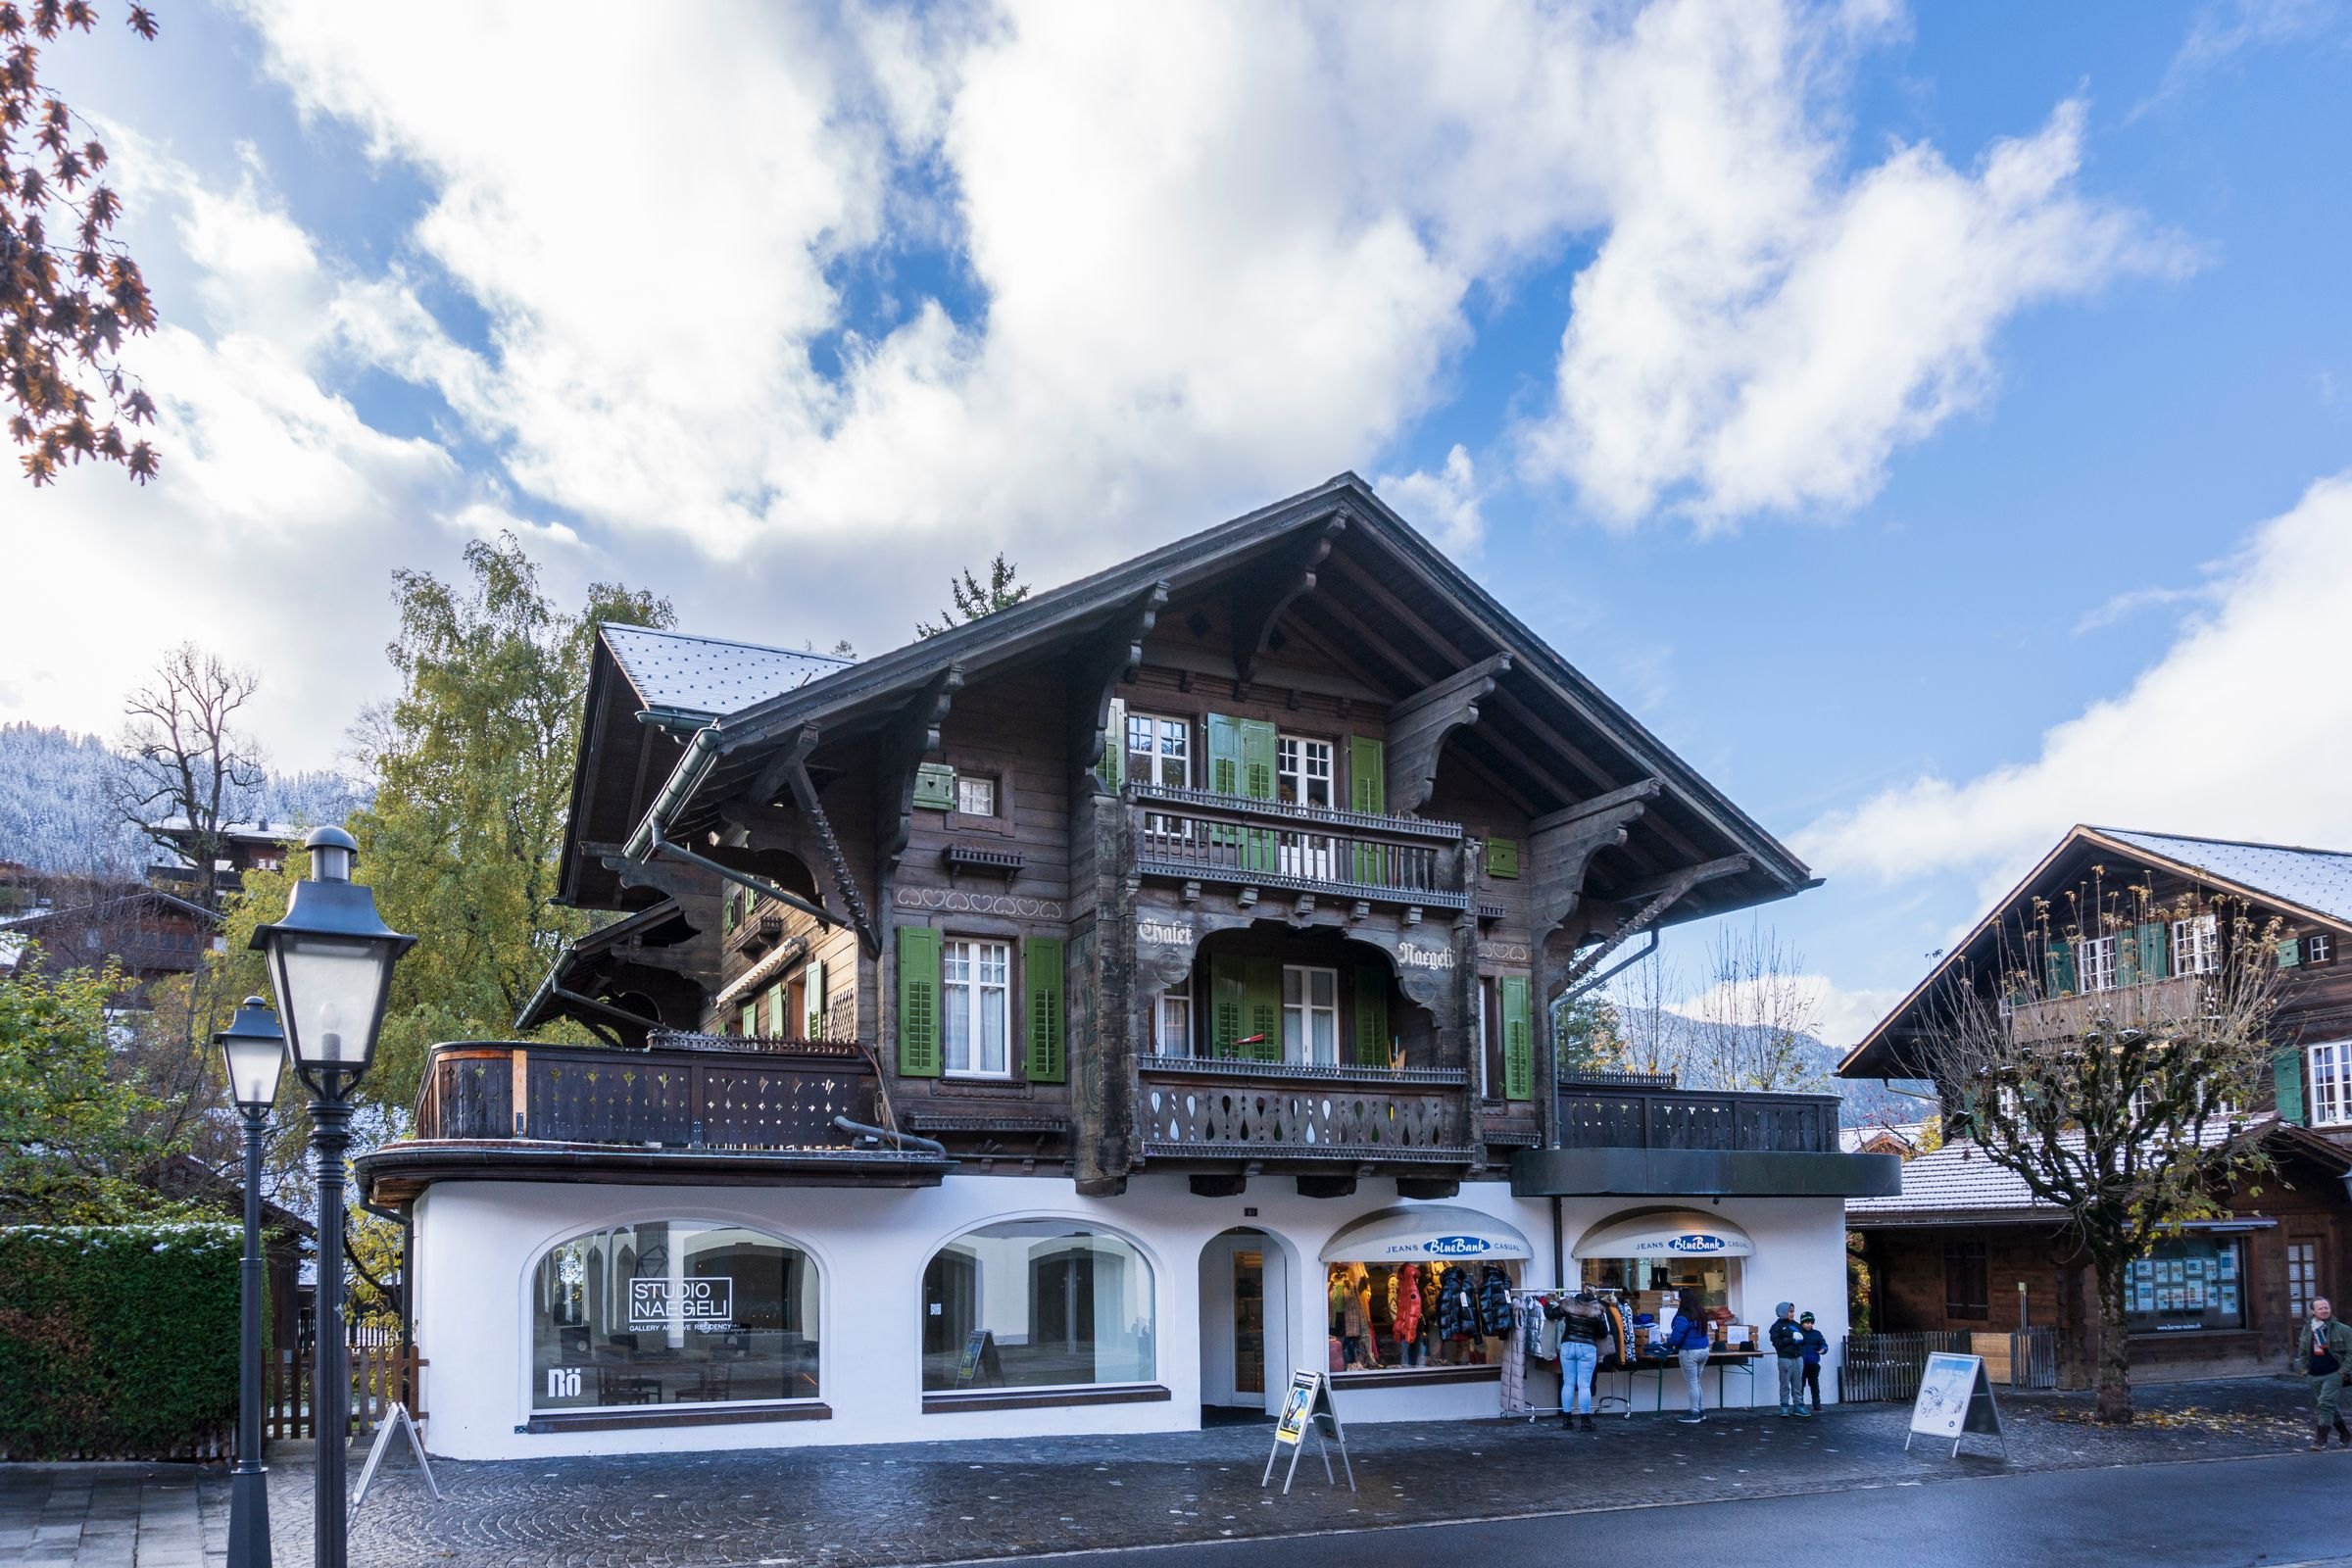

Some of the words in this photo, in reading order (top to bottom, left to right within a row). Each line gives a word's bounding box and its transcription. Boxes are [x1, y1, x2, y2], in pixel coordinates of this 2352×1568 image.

[1139, 917, 1194, 948] Chalet
[1398, 942, 1455, 970] Naegeli
[1386, 1245, 1419, 1253] JEANS
[1427, 1236, 1491, 1254] BlueBank
[1672, 1236, 1726, 1250] BlueBank
[635, 1283, 710, 1299] STUDIO
[635, 1300, 727, 1317] NAEGELI
